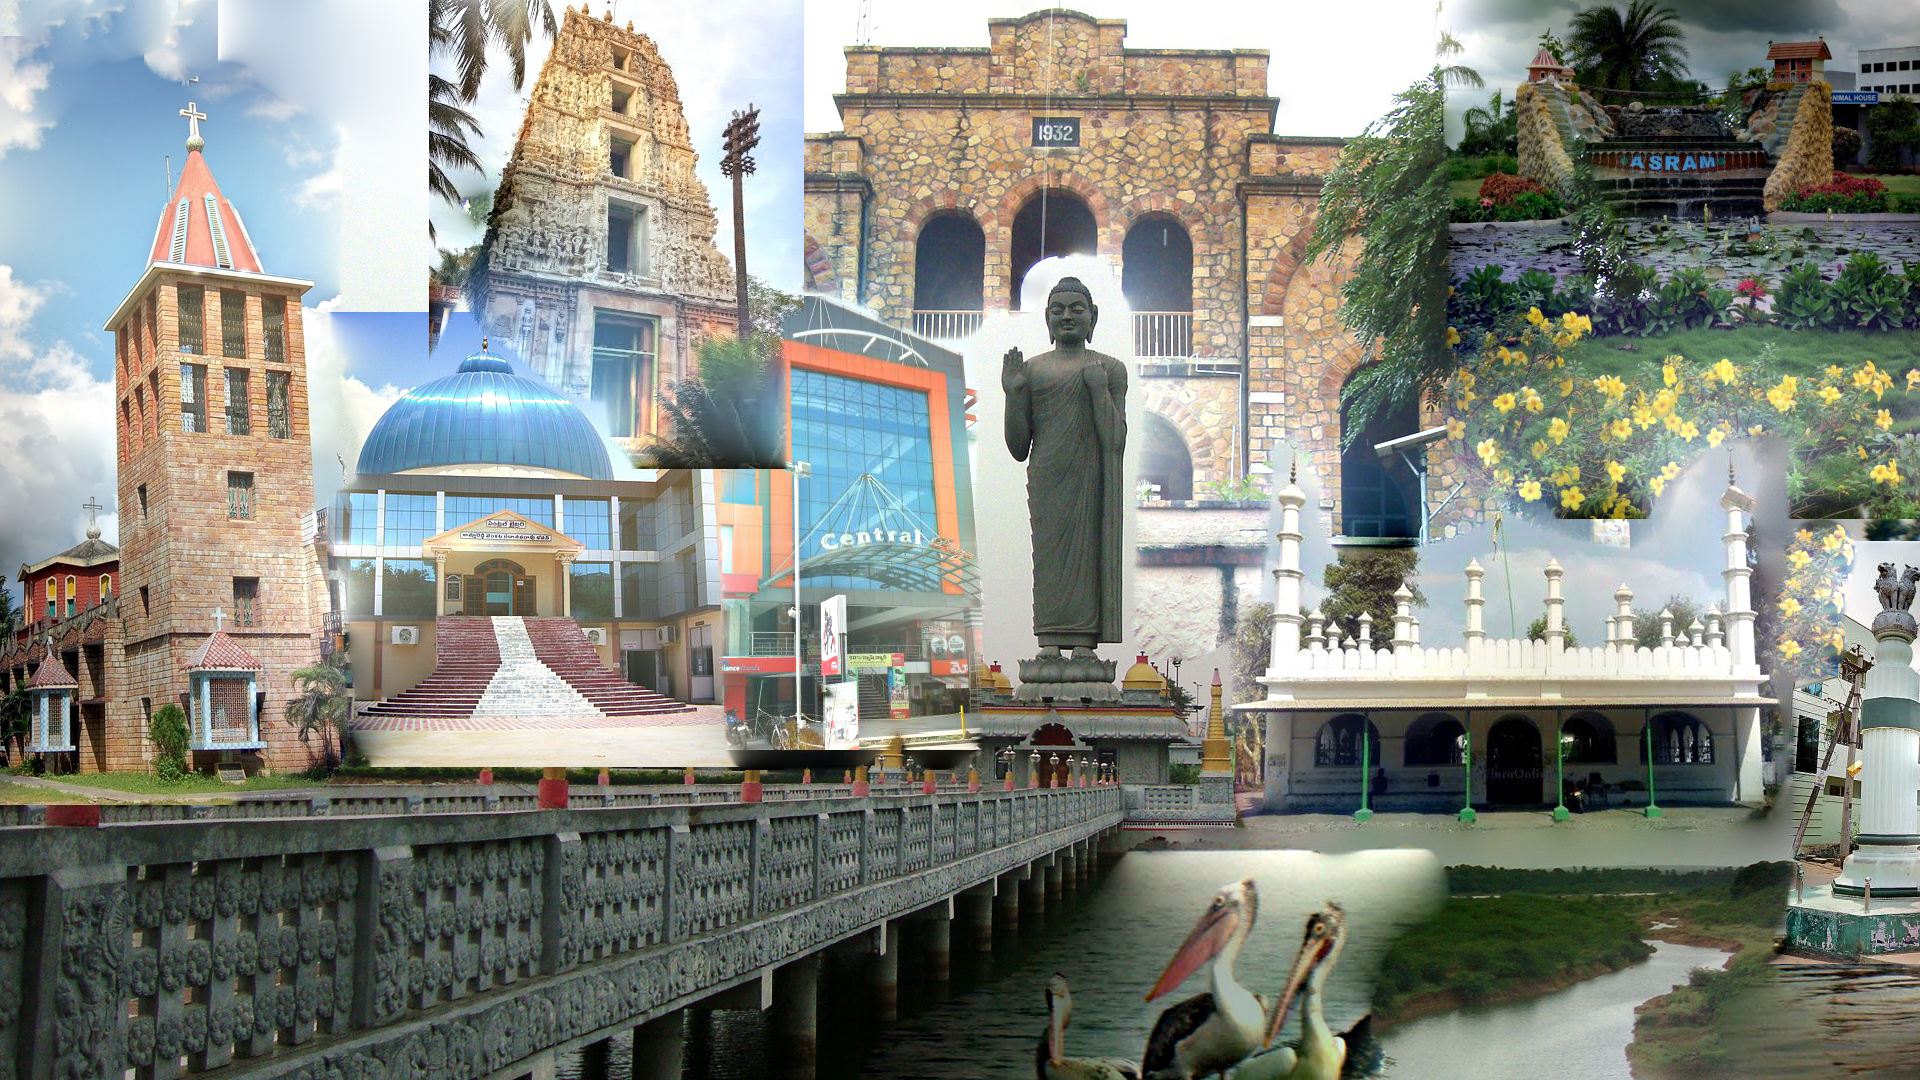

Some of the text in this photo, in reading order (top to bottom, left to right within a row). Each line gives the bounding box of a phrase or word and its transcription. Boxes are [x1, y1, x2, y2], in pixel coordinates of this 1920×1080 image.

[1831, 94, 1877, 102] NIMAL HOUSE
[1039, 125, 1073, 141] 1932
[1630, 155, 1716, 170] ASRAM
[821, 527, 921, 550] Central
